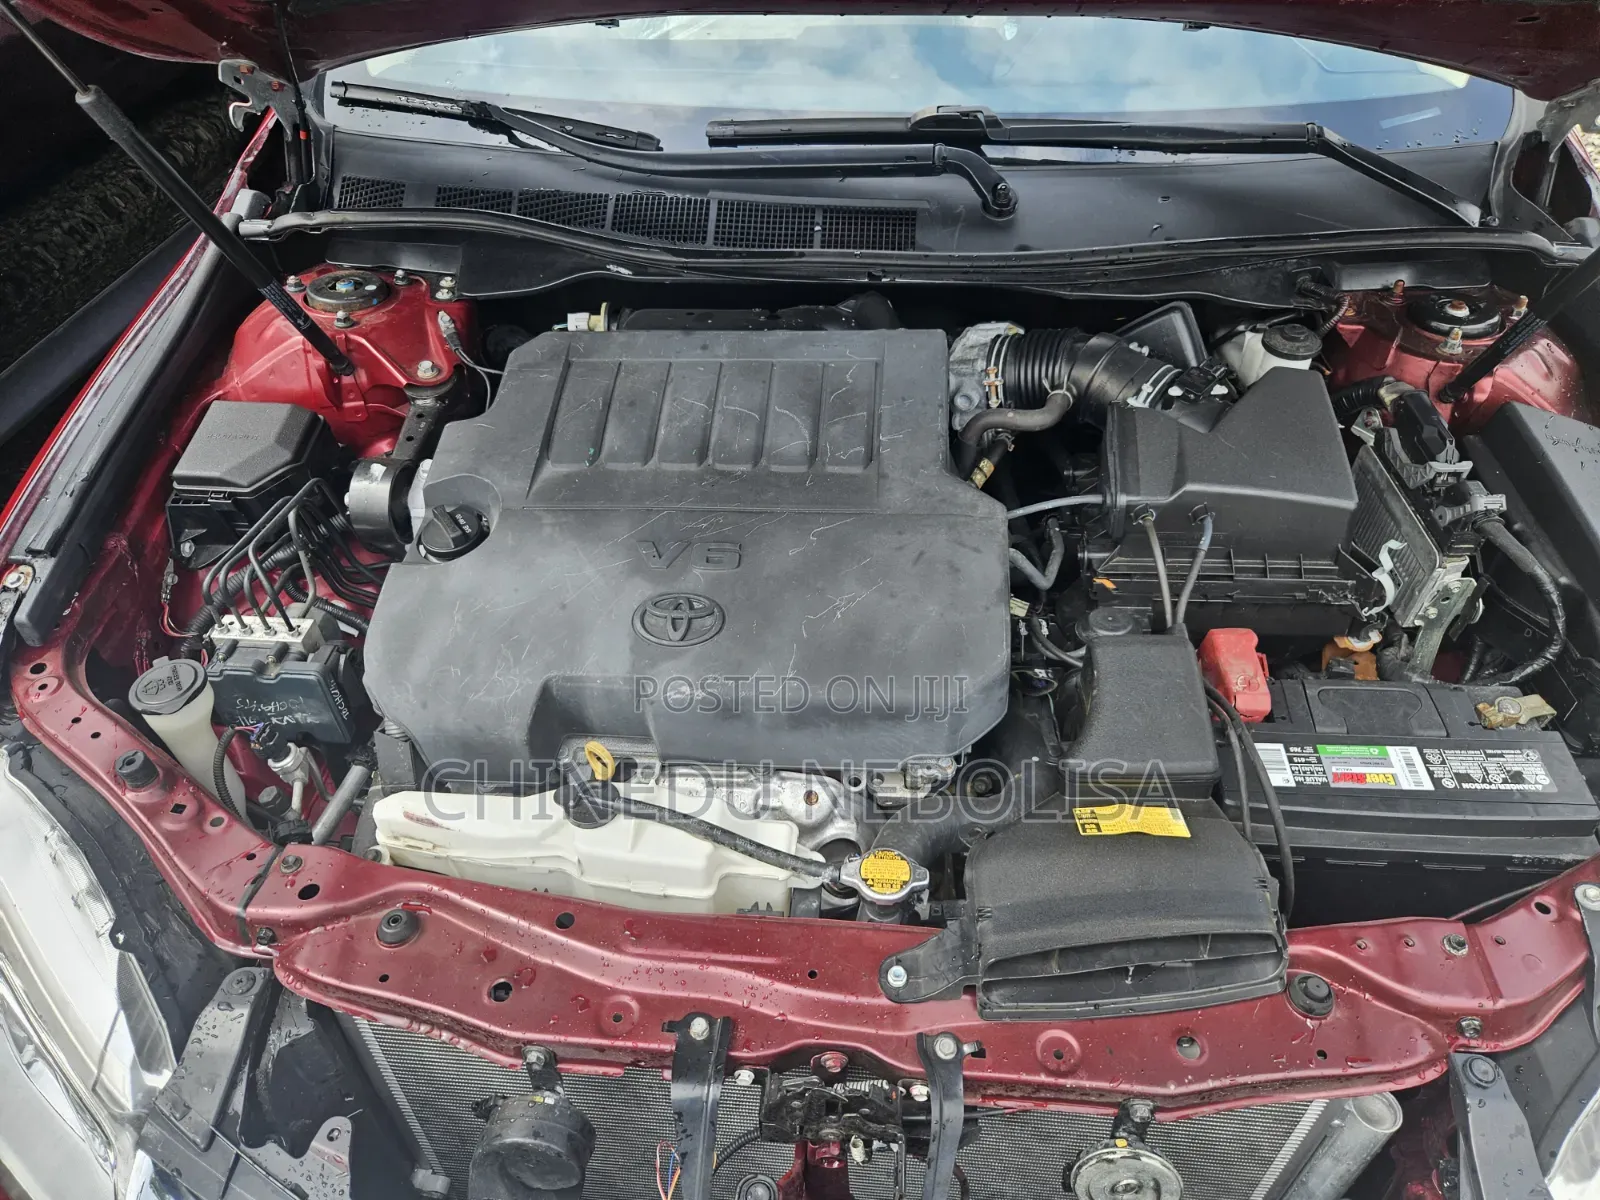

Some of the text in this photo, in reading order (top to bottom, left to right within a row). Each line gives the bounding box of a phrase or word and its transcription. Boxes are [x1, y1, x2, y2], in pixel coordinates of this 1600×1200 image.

[636, 540, 742, 572] V6
[1307, 775, 1328, 783] VALUE
[1332, 772, 1397, 786] EverStart
